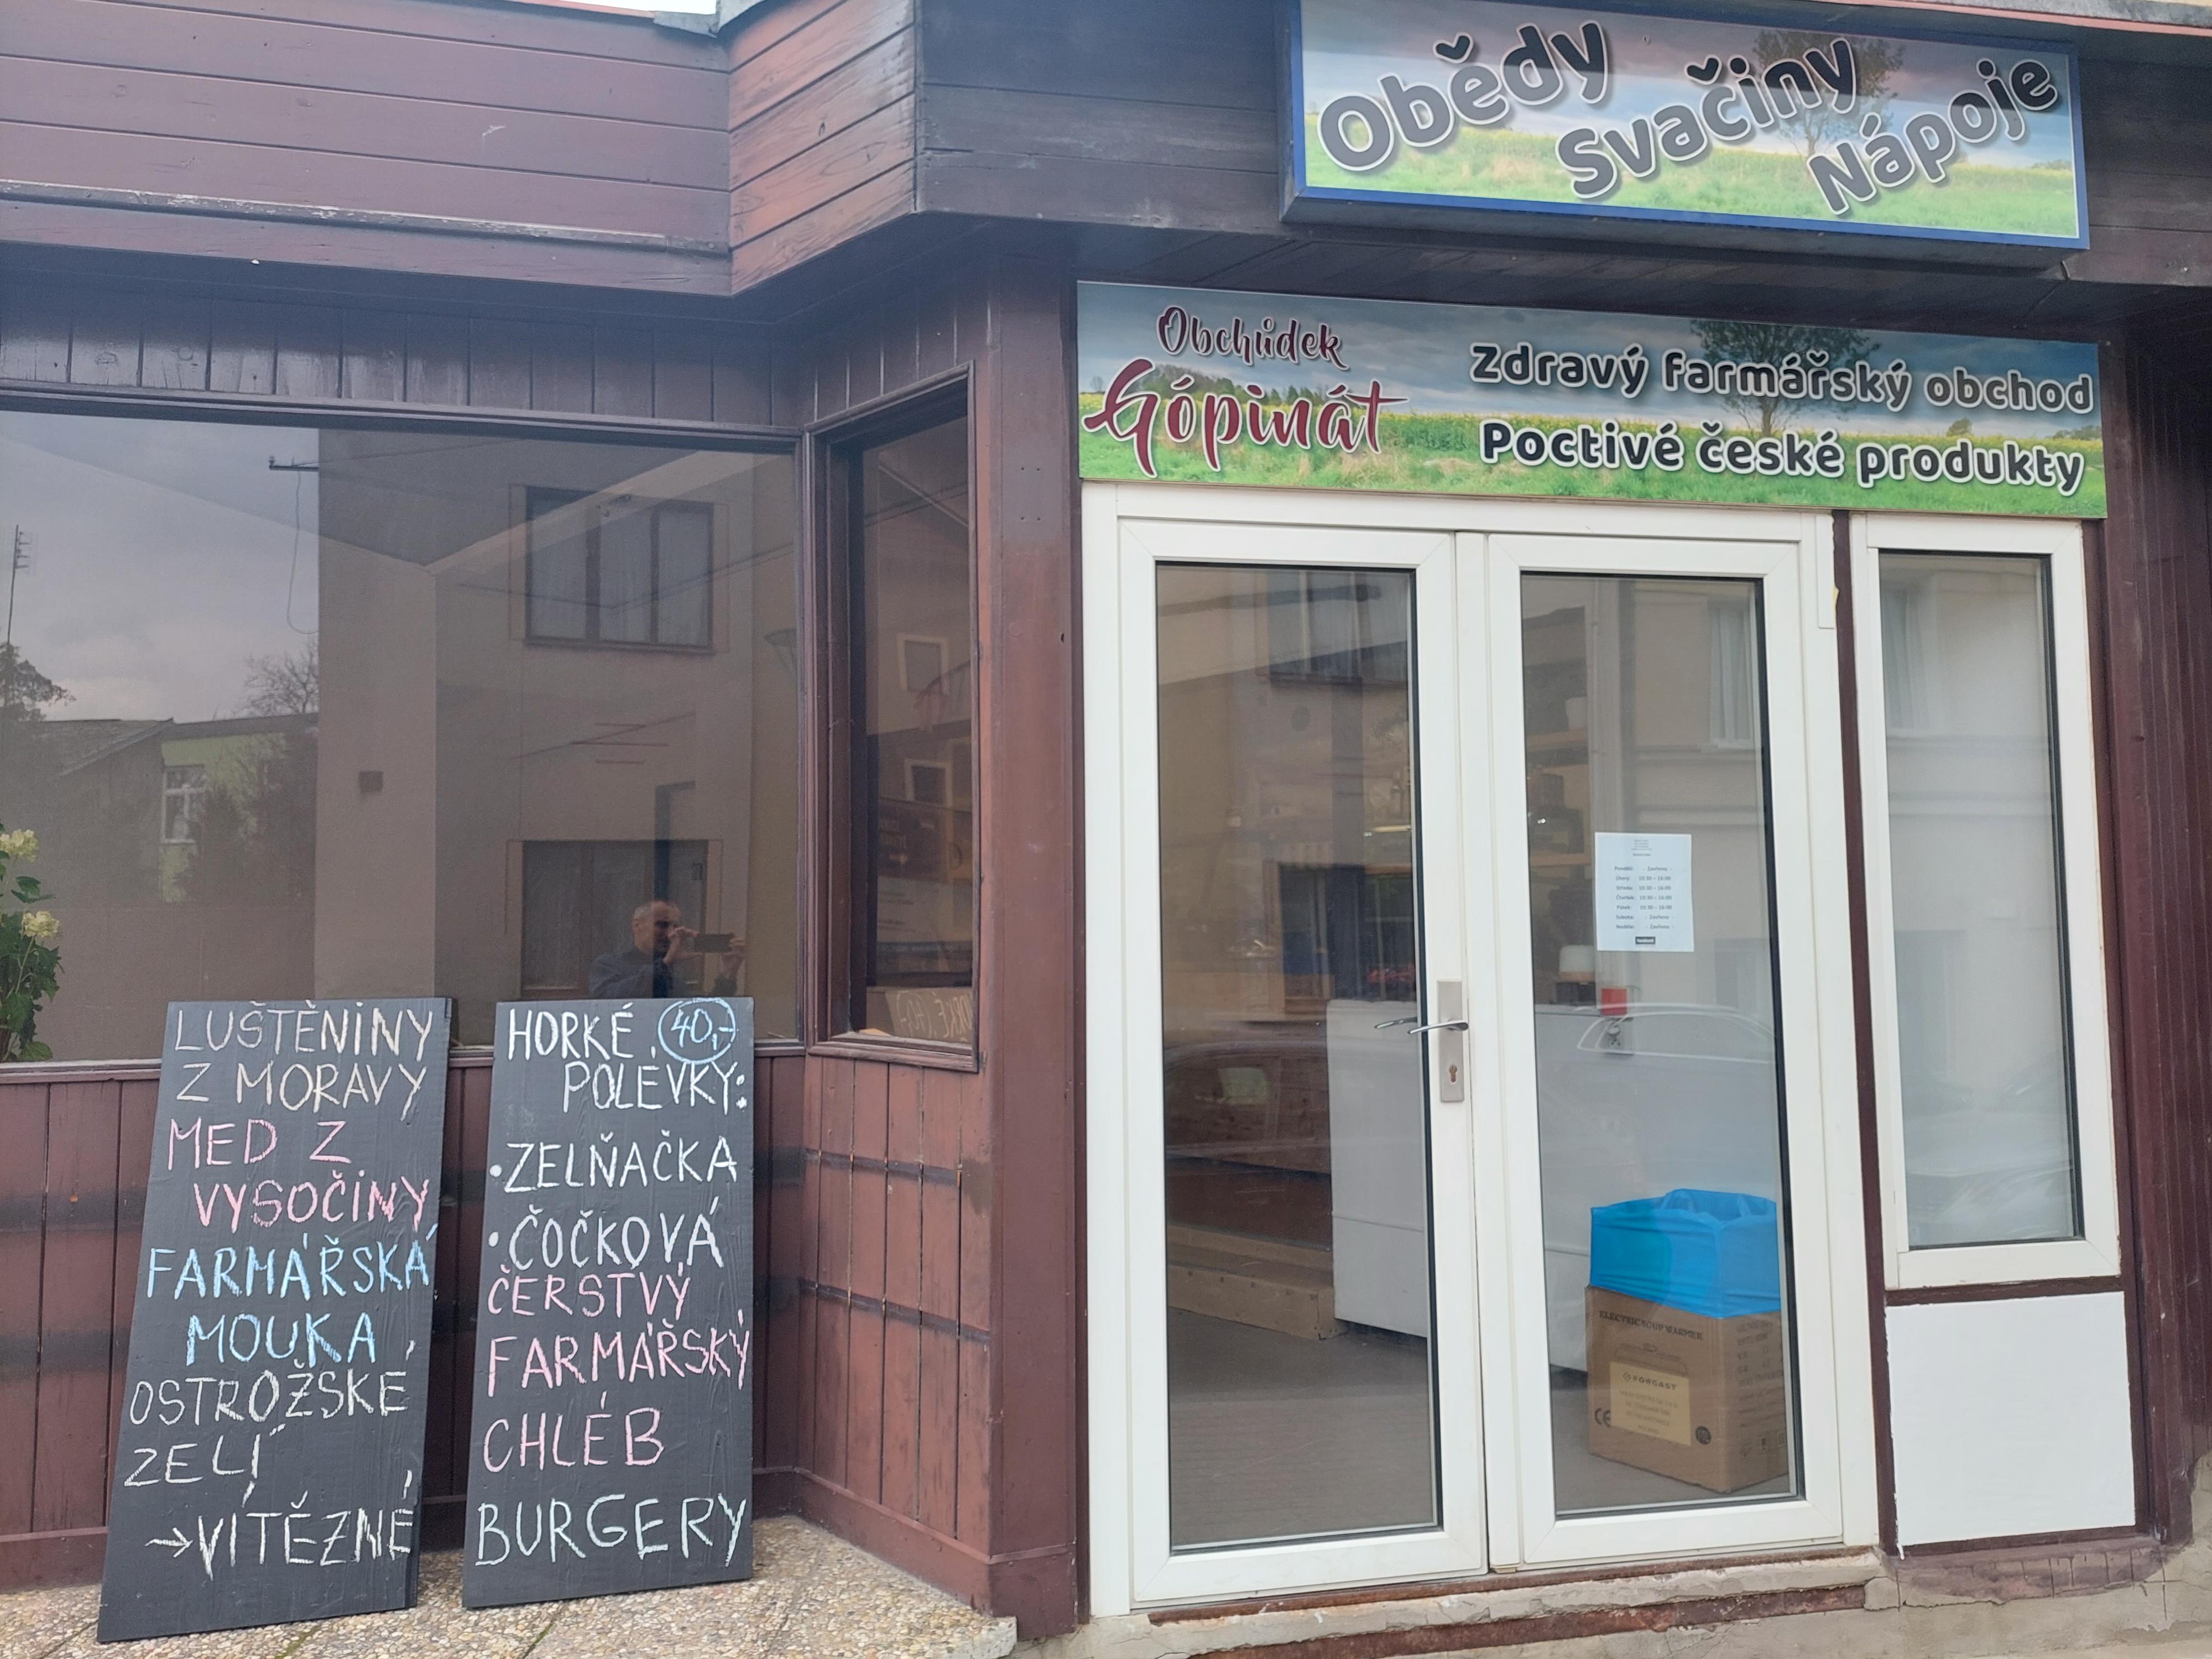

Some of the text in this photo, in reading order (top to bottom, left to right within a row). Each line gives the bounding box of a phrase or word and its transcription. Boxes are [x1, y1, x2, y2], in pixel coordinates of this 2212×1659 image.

[1319, 21, 1610, 171] Obědy
[1557, 38, 1857, 199] Svačiny
[1806, 59, 2058, 215] Nápoje
[1157, 306, 1349, 369] Obchůdek
[1470, 341, 2094, 414] Zdravý farmářský obchod
[1082, 358, 1408, 477] Gópinát
[1480, 419, 2084, 497] Poctivé české produkty
[174, 1000, 433, 1062] LUŠTĚNINY
[508, 1002, 633, 1061] HORKÉ
[176, 1060, 427, 1122] Z MORAVY
[564, 1046, 747, 1115] POLÉVKY:
[168, 1116, 352, 1171] MED Z
[504, 1130, 737, 1193] ZELŇAČKA
[194, 1170, 430, 1233] VYSOČINY
[508, 1196, 724, 1271] ČOČKOVÁ
[147, 1223, 439, 1301] FARMÁŘSKÁ
[488, 1262, 690, 1321] ČERSTVÝ
[186, 1312, 376, 1368] MOUKA
[488, 1308, 750, 1397] FARMÁŘSKÝ
[129, 1339, 416, 1426] OSTROŽSKÉ
[124, 1423, 286, 1486] ZELÍ
[483, 1390, 665, 1473] CHLÉB
[475, 1494, 747, 1567] BURGERY
